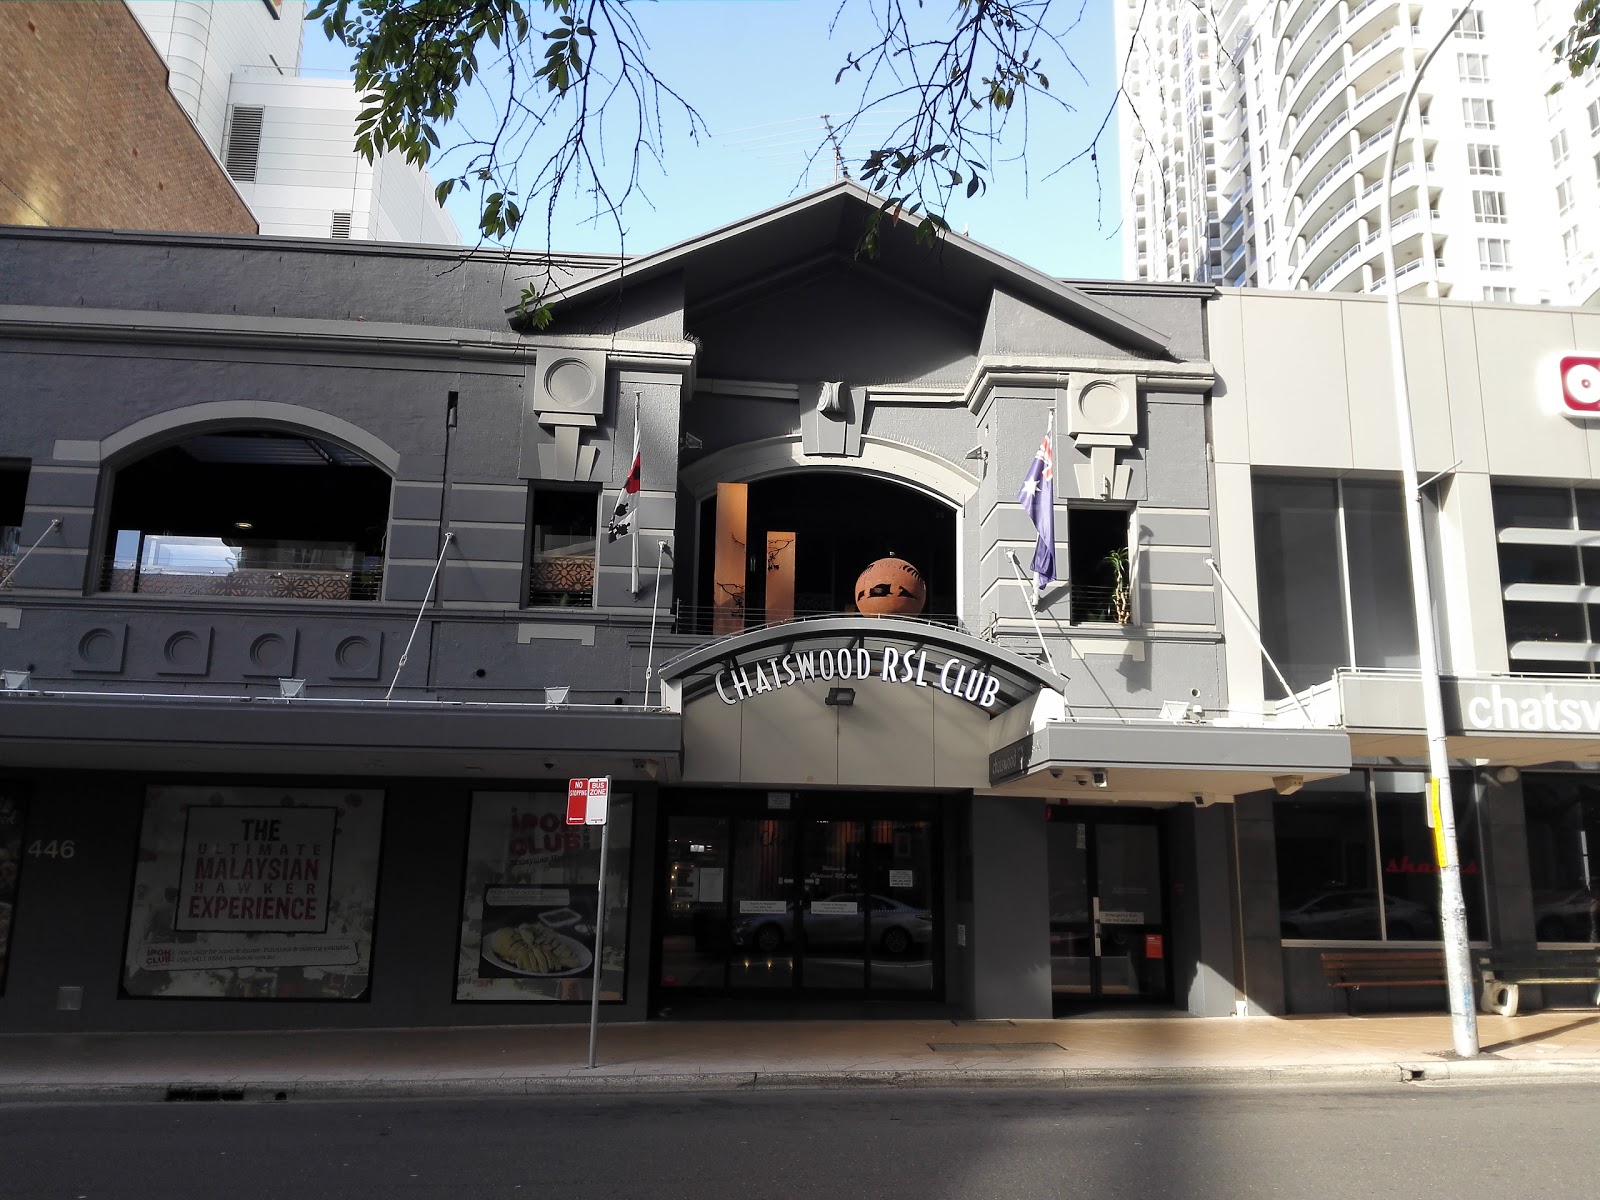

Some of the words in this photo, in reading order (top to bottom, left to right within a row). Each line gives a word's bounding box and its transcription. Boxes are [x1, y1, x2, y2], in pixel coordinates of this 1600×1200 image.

[714, 648, 871, 705] CHATSWOOD
[880, 647, 928, 687] RSL
[940, 658, 1001, 708] CLUB
[574, 781, 584, 789] NO
[589, 788, 606, 796] ZONE
[241, 819, 281, 841] THE
[28, 839, 75, 859] 446
[197, 843, 321, 856] ULTIMATE
[194, 857, 320, 881] MALAYSIAN
[194, 882, 316, 895] HAWKER
[188, 896, 318, 920] EXPERIENCE
